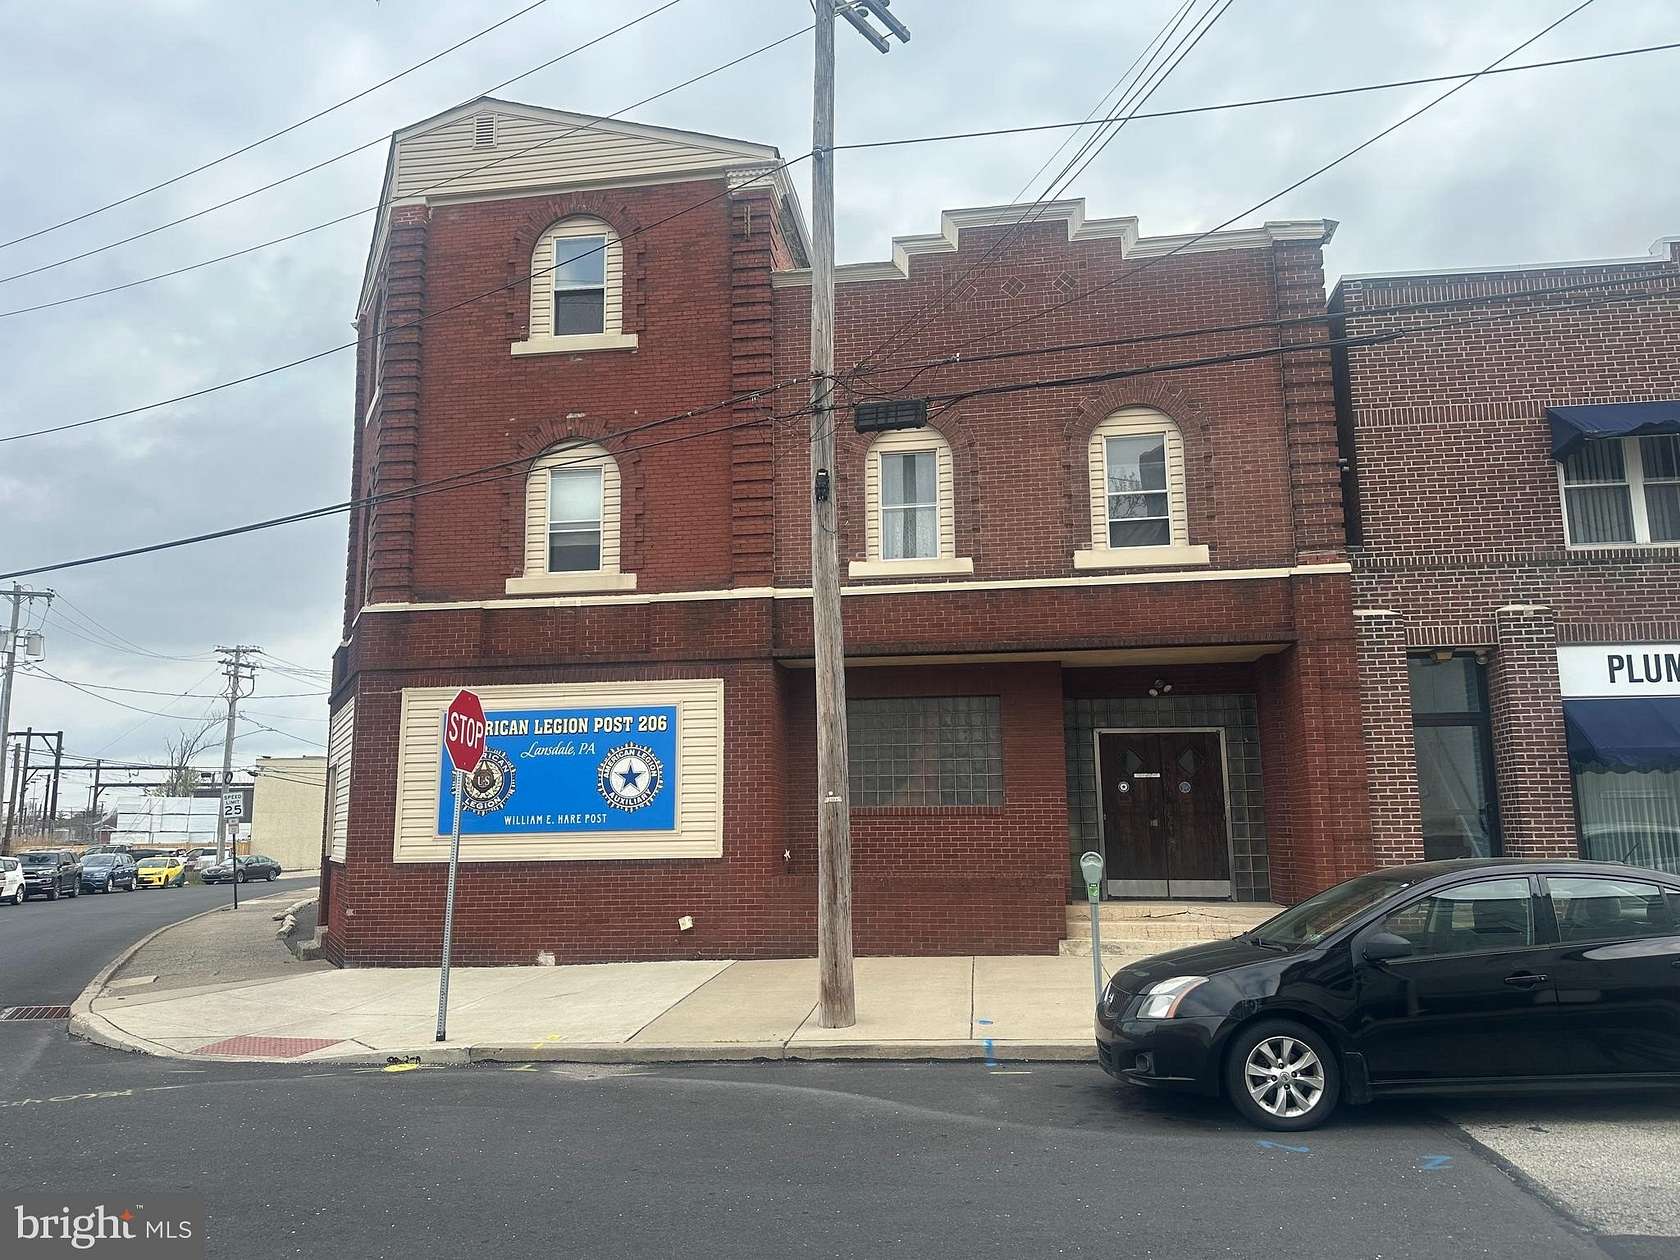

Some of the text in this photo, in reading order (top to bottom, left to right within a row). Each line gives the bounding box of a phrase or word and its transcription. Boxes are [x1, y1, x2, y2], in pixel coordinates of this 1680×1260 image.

[449, 711, 484, 749] STOP
[534, 717, 588, 735] LEGION
[593, 716, 633, 732] POST
[638, 715, 667, 732] 206
[520, 741, 596, 758] Lansdale, PA
[603, 749, 658, 778] AMERICAN LEGION
[464, 796, 502, 809] LEGION
[608, 788, 652, 805] AUXILIARY
[225, 805, 241, 815] 25
[504, 813, 608, 825] WILLIAM E. HARE POST
